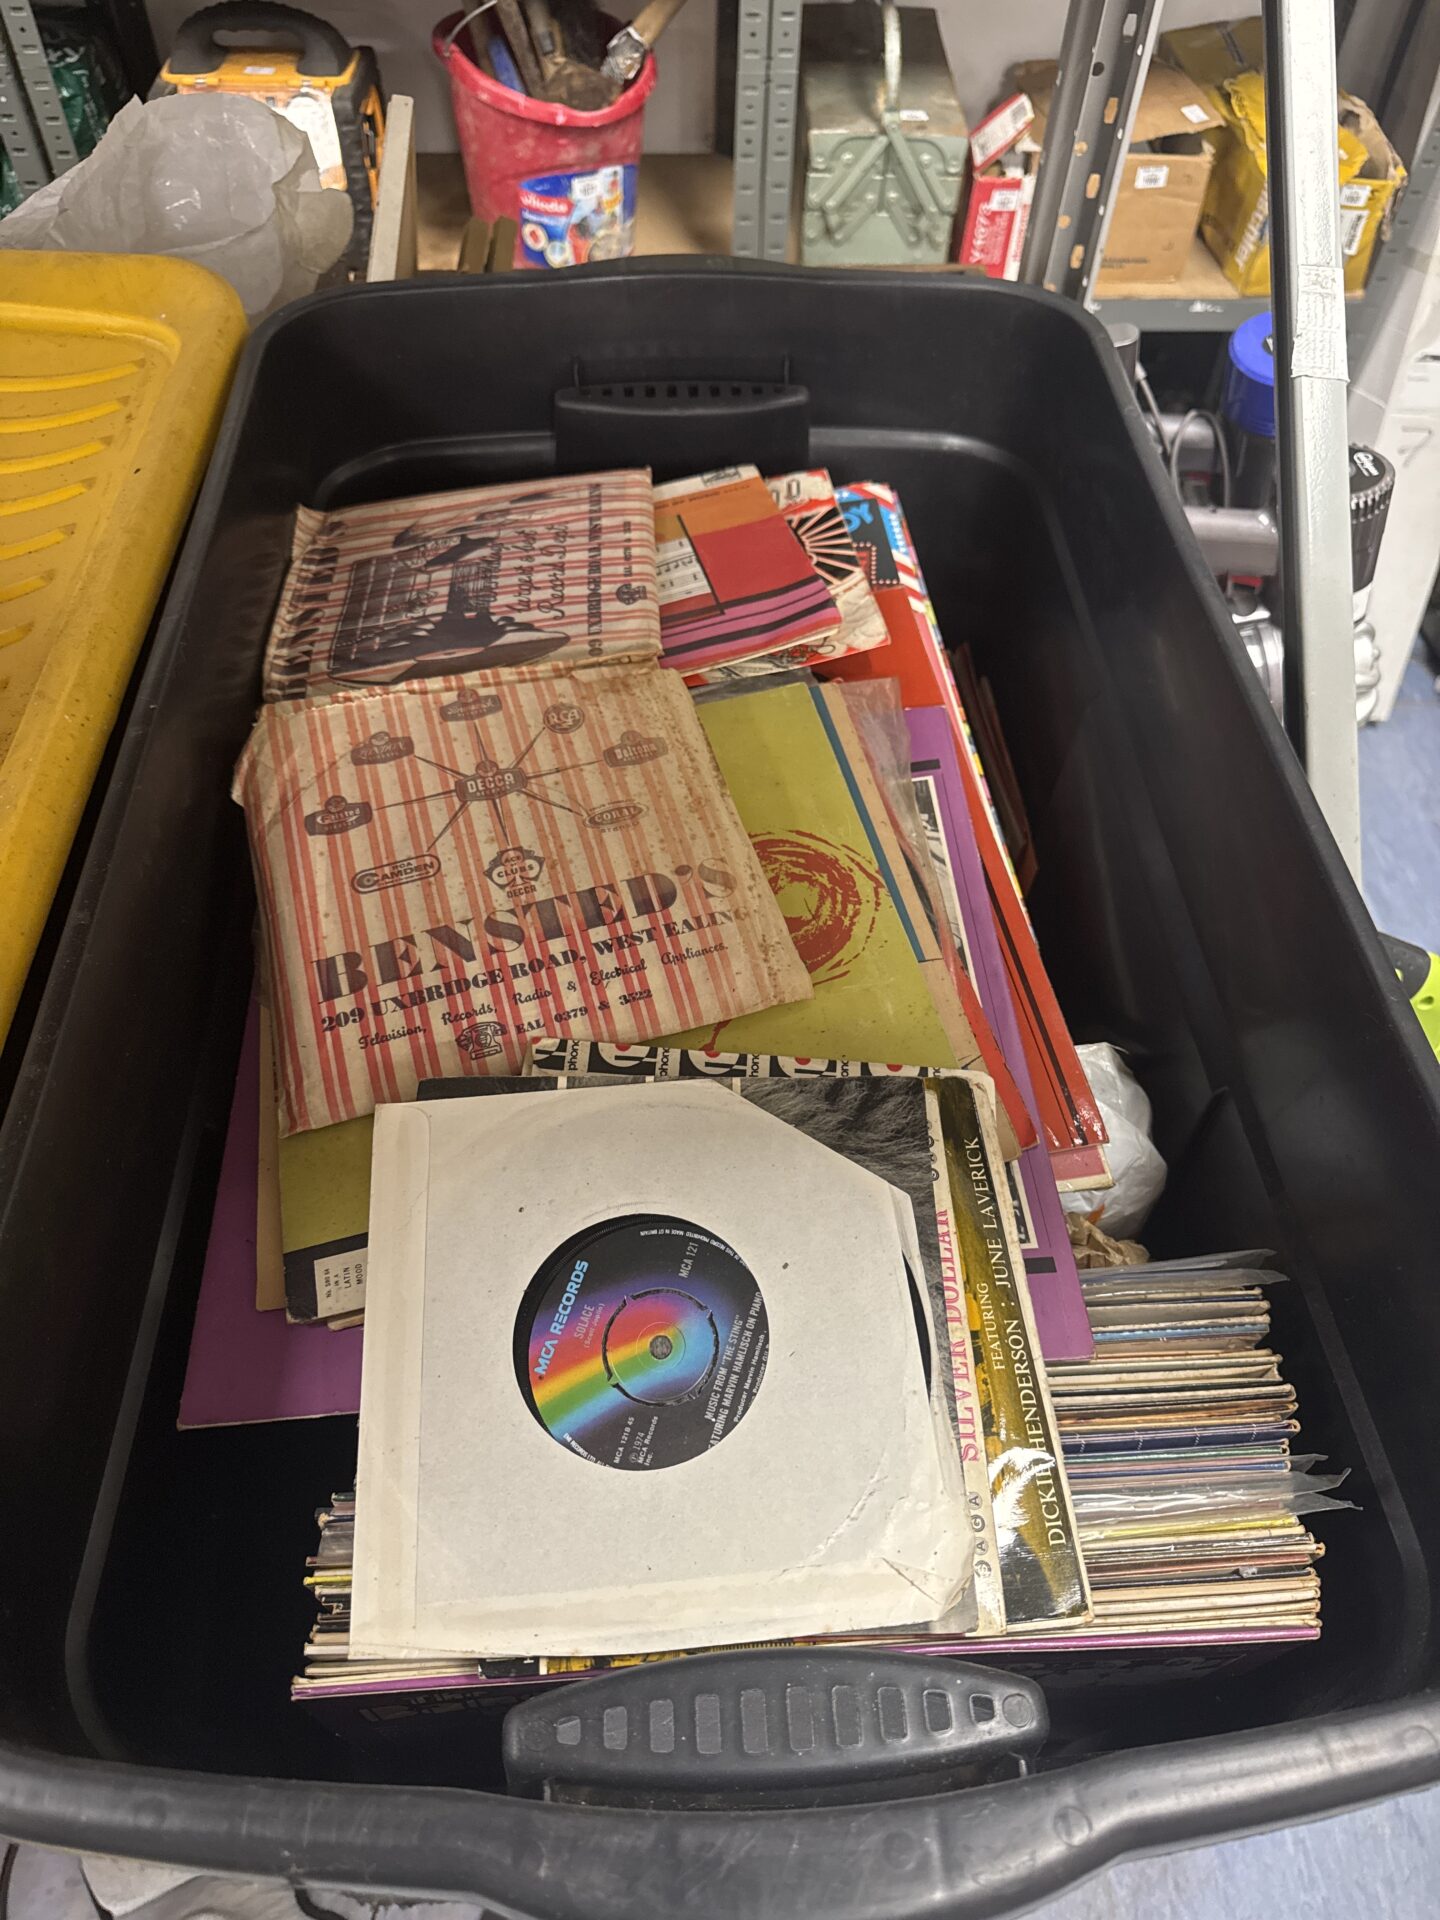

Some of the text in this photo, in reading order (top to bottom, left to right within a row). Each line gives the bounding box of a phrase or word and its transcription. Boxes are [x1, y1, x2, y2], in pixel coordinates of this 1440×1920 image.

[588, 639, 603, 657] 09
[549, 710, 581, 728] RCA
[466, 772, 515, 793] DECCA
[355, 862, 435, 889] CAMDEN
[497, 863, 534, 878] CLUBS
[506, 885, 537, 899] DECCA
[311, 858, 738, 1005] BENSTED'S
[321, 1007, 365, 1033] 209
[371, 968, 505, 1017] UXBRIDGE
[510, 949, 587, 979] ROAD,
[592, 927, 658, 956] WEST
[358, 1025, 427, 1050] Television,
[440, 1002, 498, 1026] Records,
[512, 988, 552, 1006] Radio
[566, 980, 577, 993] &
[589, 959, 648, 986] Electrical
[515, 988, 653, 1035] EAL 0379 & 3522
[964, 1137, 998, 1229] LAVERICK
[343, 1267, 352, 1289] LATIN
[355, 1264, 364, 1285] MOOD
[678, 1242, 699, 1278] MCA 121
[987, 1238, 1011, 1289] JUNE
[534, 1260, 589, 1375] MCA RECORDS
[574, 1304, 595, 1340] SOLACE
[983, 1282, 1006, 1370] FEATURING
[704, 1314, 744, 1421] MUSIC FROM "THE STING"
[708, 1291, 763, 1450] EATURING MARVIN HAMLISCH ON PIANO
[733, 1334, 765, 1423] Producer Marvin Hamlisch
[1004, 1319, 1047, 1452] HENDERSON
[951, 1339, 980, 1463] SILVER
[614, 1447, 625, 1463] MCA
[627, 1416, 635, 1426] 45
[632, 1432, 645, 1450] 1974
[637, 1416, 659, 1464] MCA Records
[643, 1452, 654, 1466] Inc.
